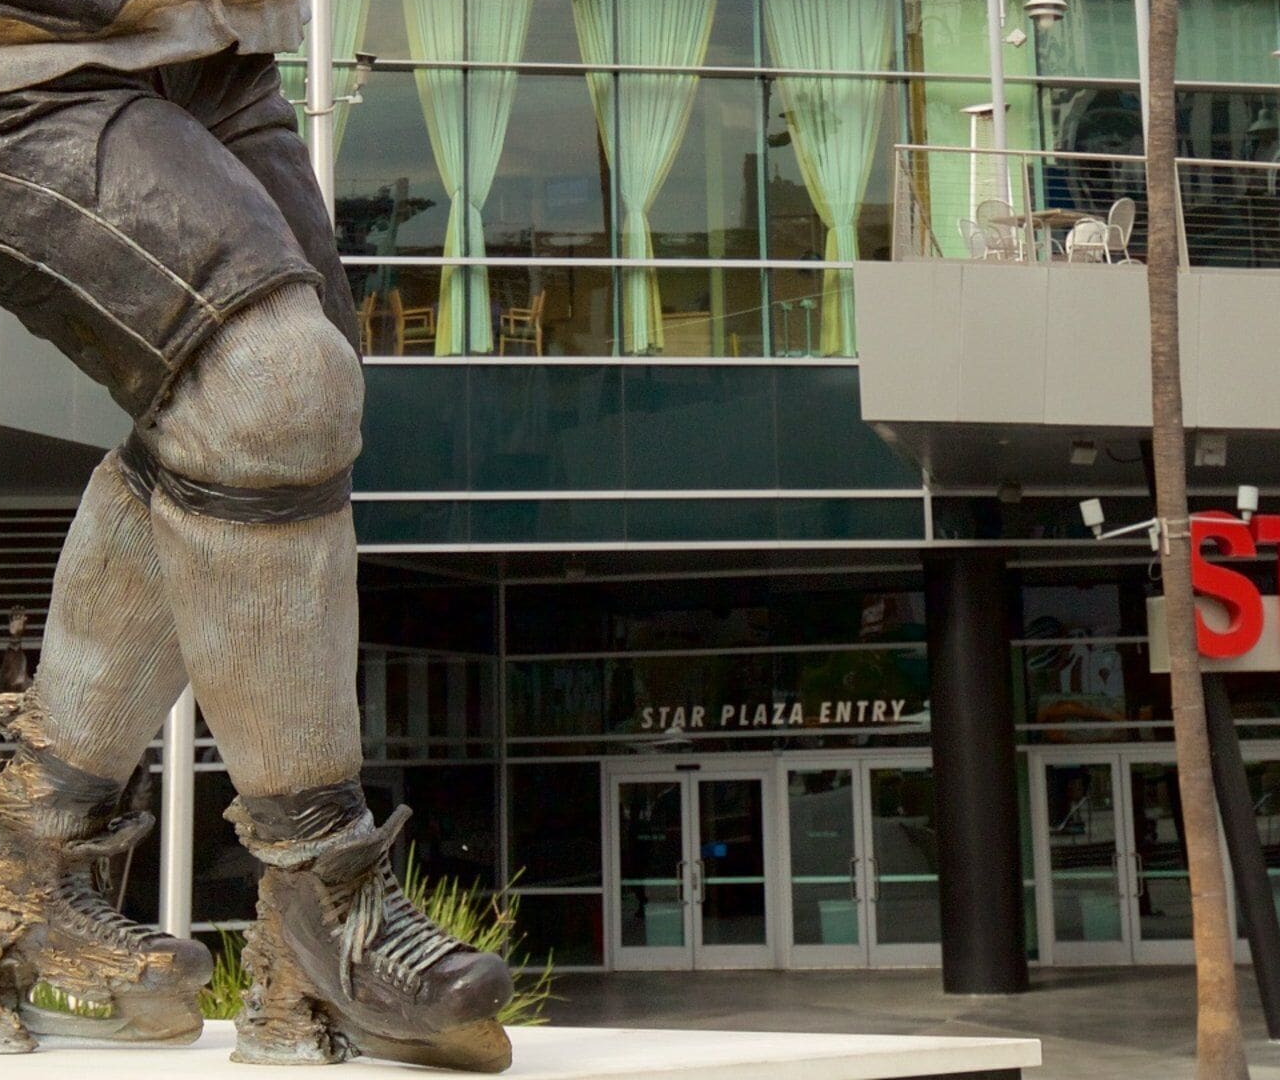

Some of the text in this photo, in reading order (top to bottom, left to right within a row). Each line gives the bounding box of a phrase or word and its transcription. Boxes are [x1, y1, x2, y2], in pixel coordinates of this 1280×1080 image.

[641, 698, 907, 729] STAR PLAZA ENTRY
